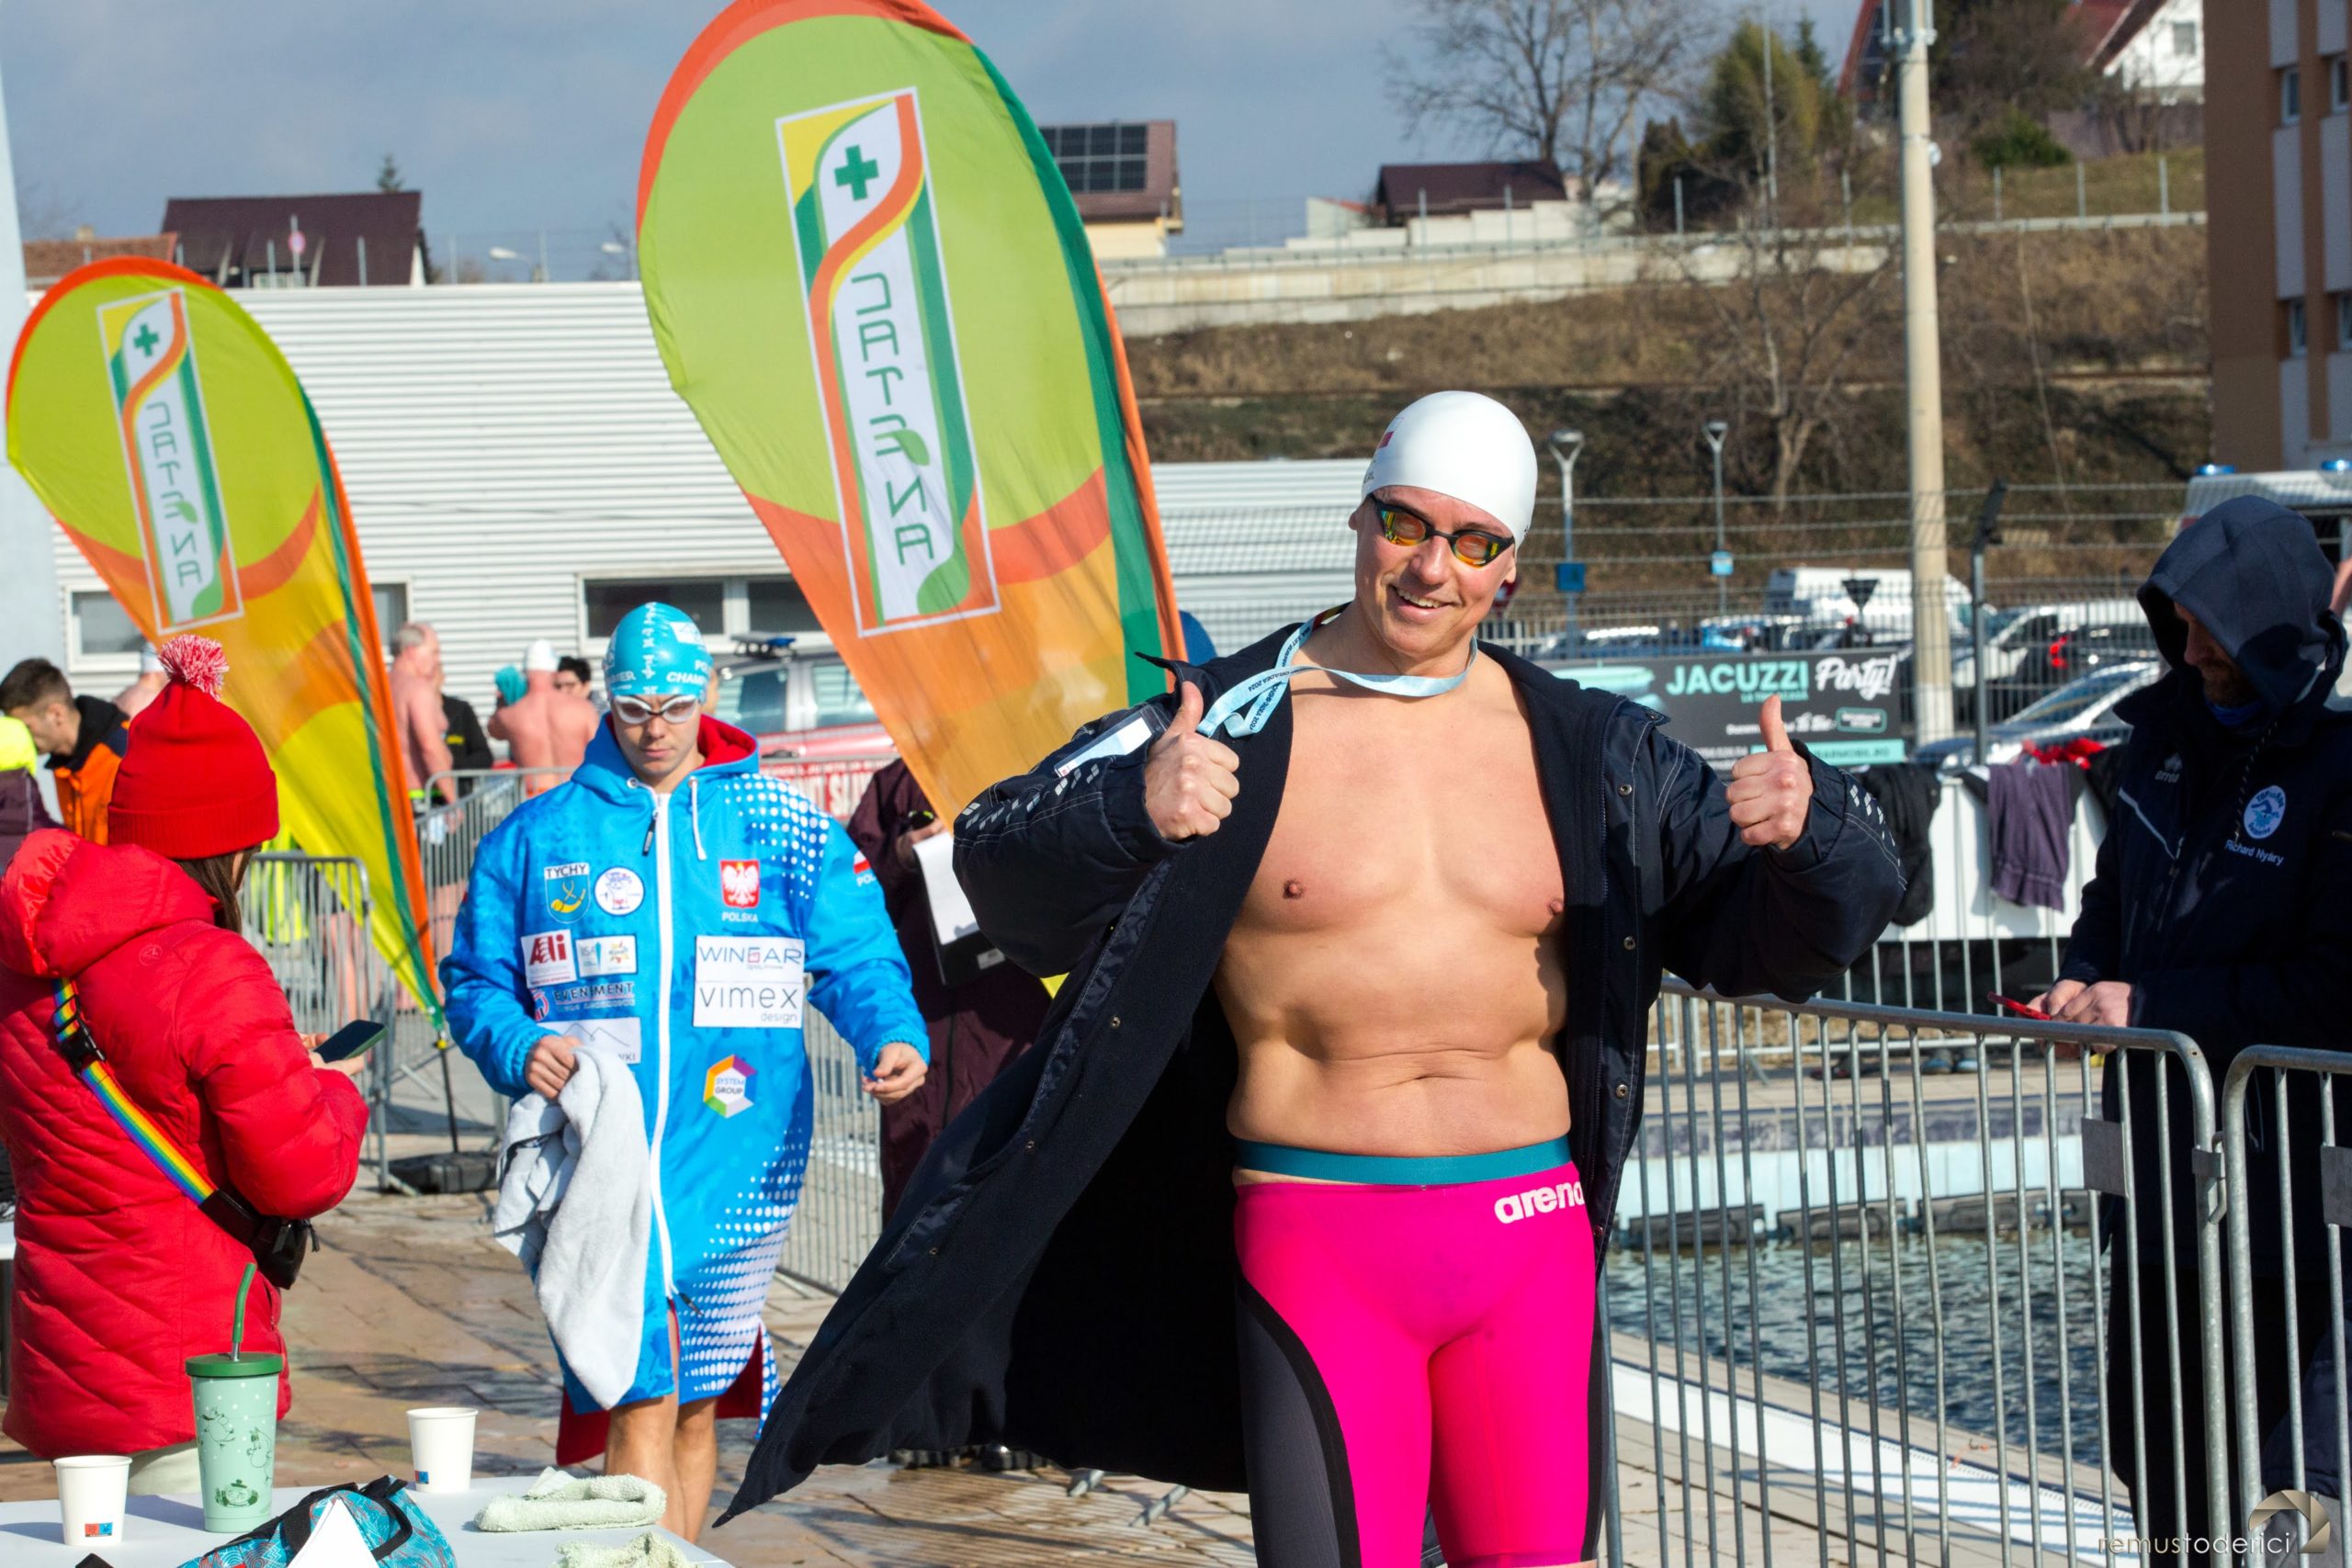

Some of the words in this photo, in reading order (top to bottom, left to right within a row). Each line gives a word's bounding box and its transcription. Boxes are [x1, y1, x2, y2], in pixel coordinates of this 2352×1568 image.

[1666, 660, 1809, 695] JACUZZI
[1815, 654, 1897, 701] Party!
[1248, 681, 1261, 692] 2024
[2225, 840, 2256, 856] Richard
[546, 863, 586, 879] TYCHY
[721, 911, 759, 923] POLSKA
[699, 987, 798, 1010] vimex
[761, 1012, 798, 1024] design
[715, 1077, 745, 1086] SYSTEM
[715, 1086, 744, 1095] GROUP
[1494, 1181, 1586, 1224] arena
